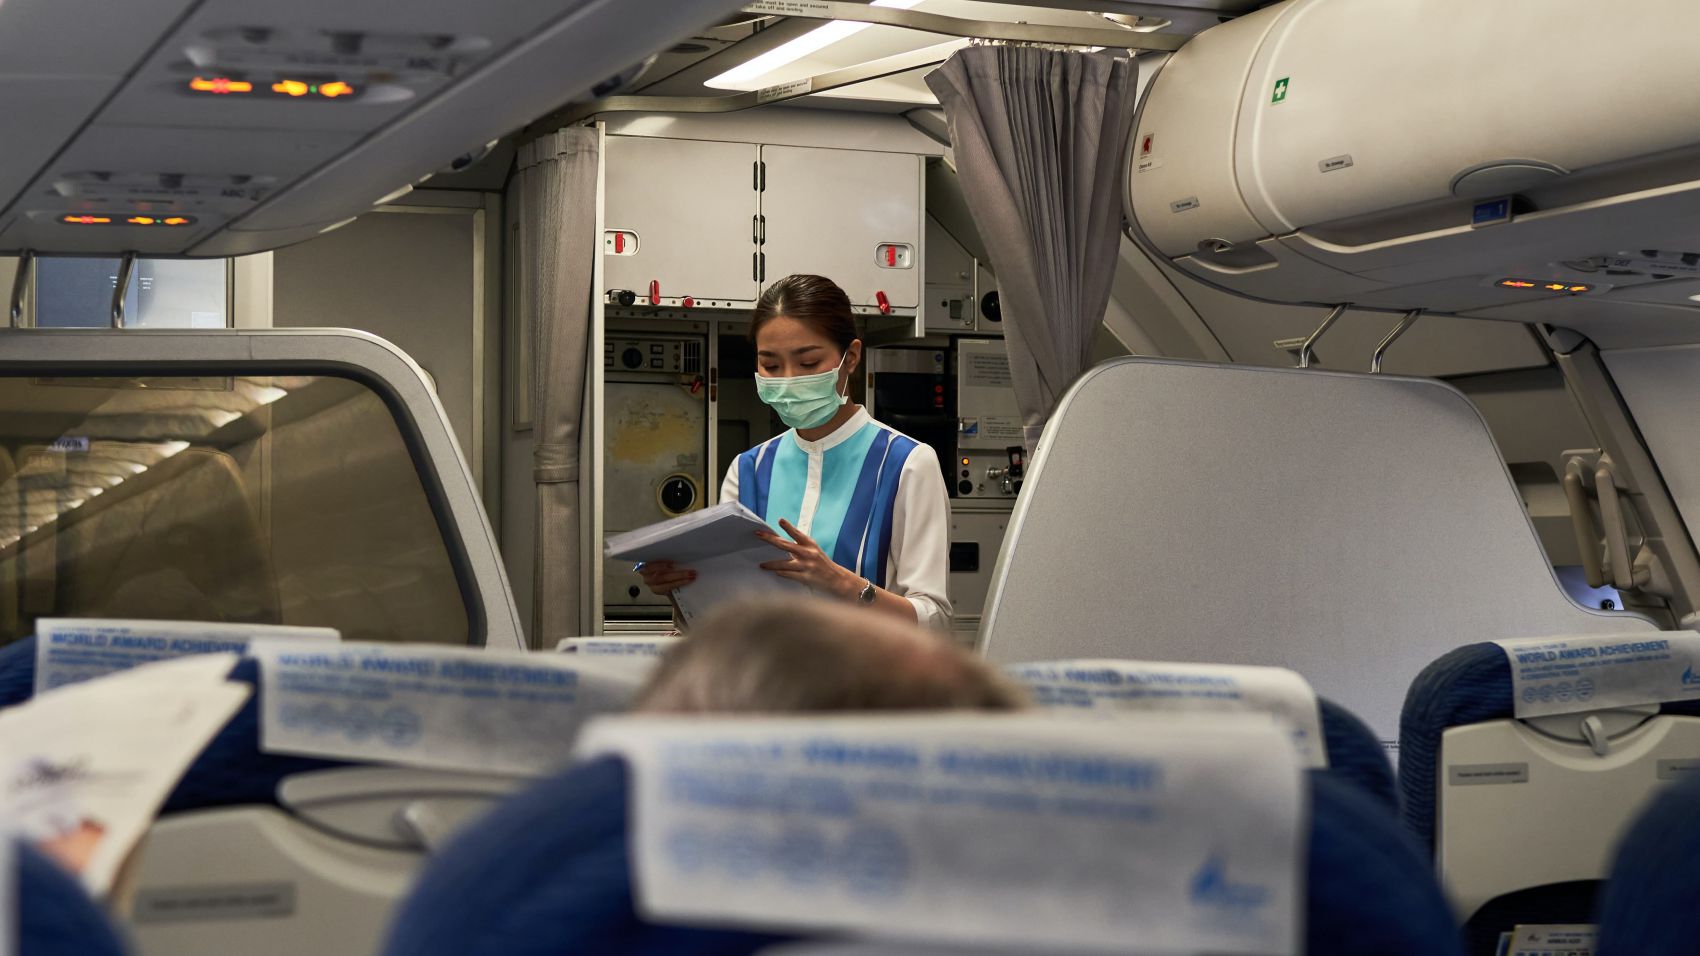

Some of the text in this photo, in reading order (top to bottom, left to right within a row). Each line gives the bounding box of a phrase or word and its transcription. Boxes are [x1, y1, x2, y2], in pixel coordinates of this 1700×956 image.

[52, 633, 108, 647] WORLD
[111, 636, 167, 651] AWARD
[1516, 650, 1557, 664] WORLD
[1559, 647, 1596, 660] AWARD
[1599, 640, 1670, 656] ACHIEVEMENT
